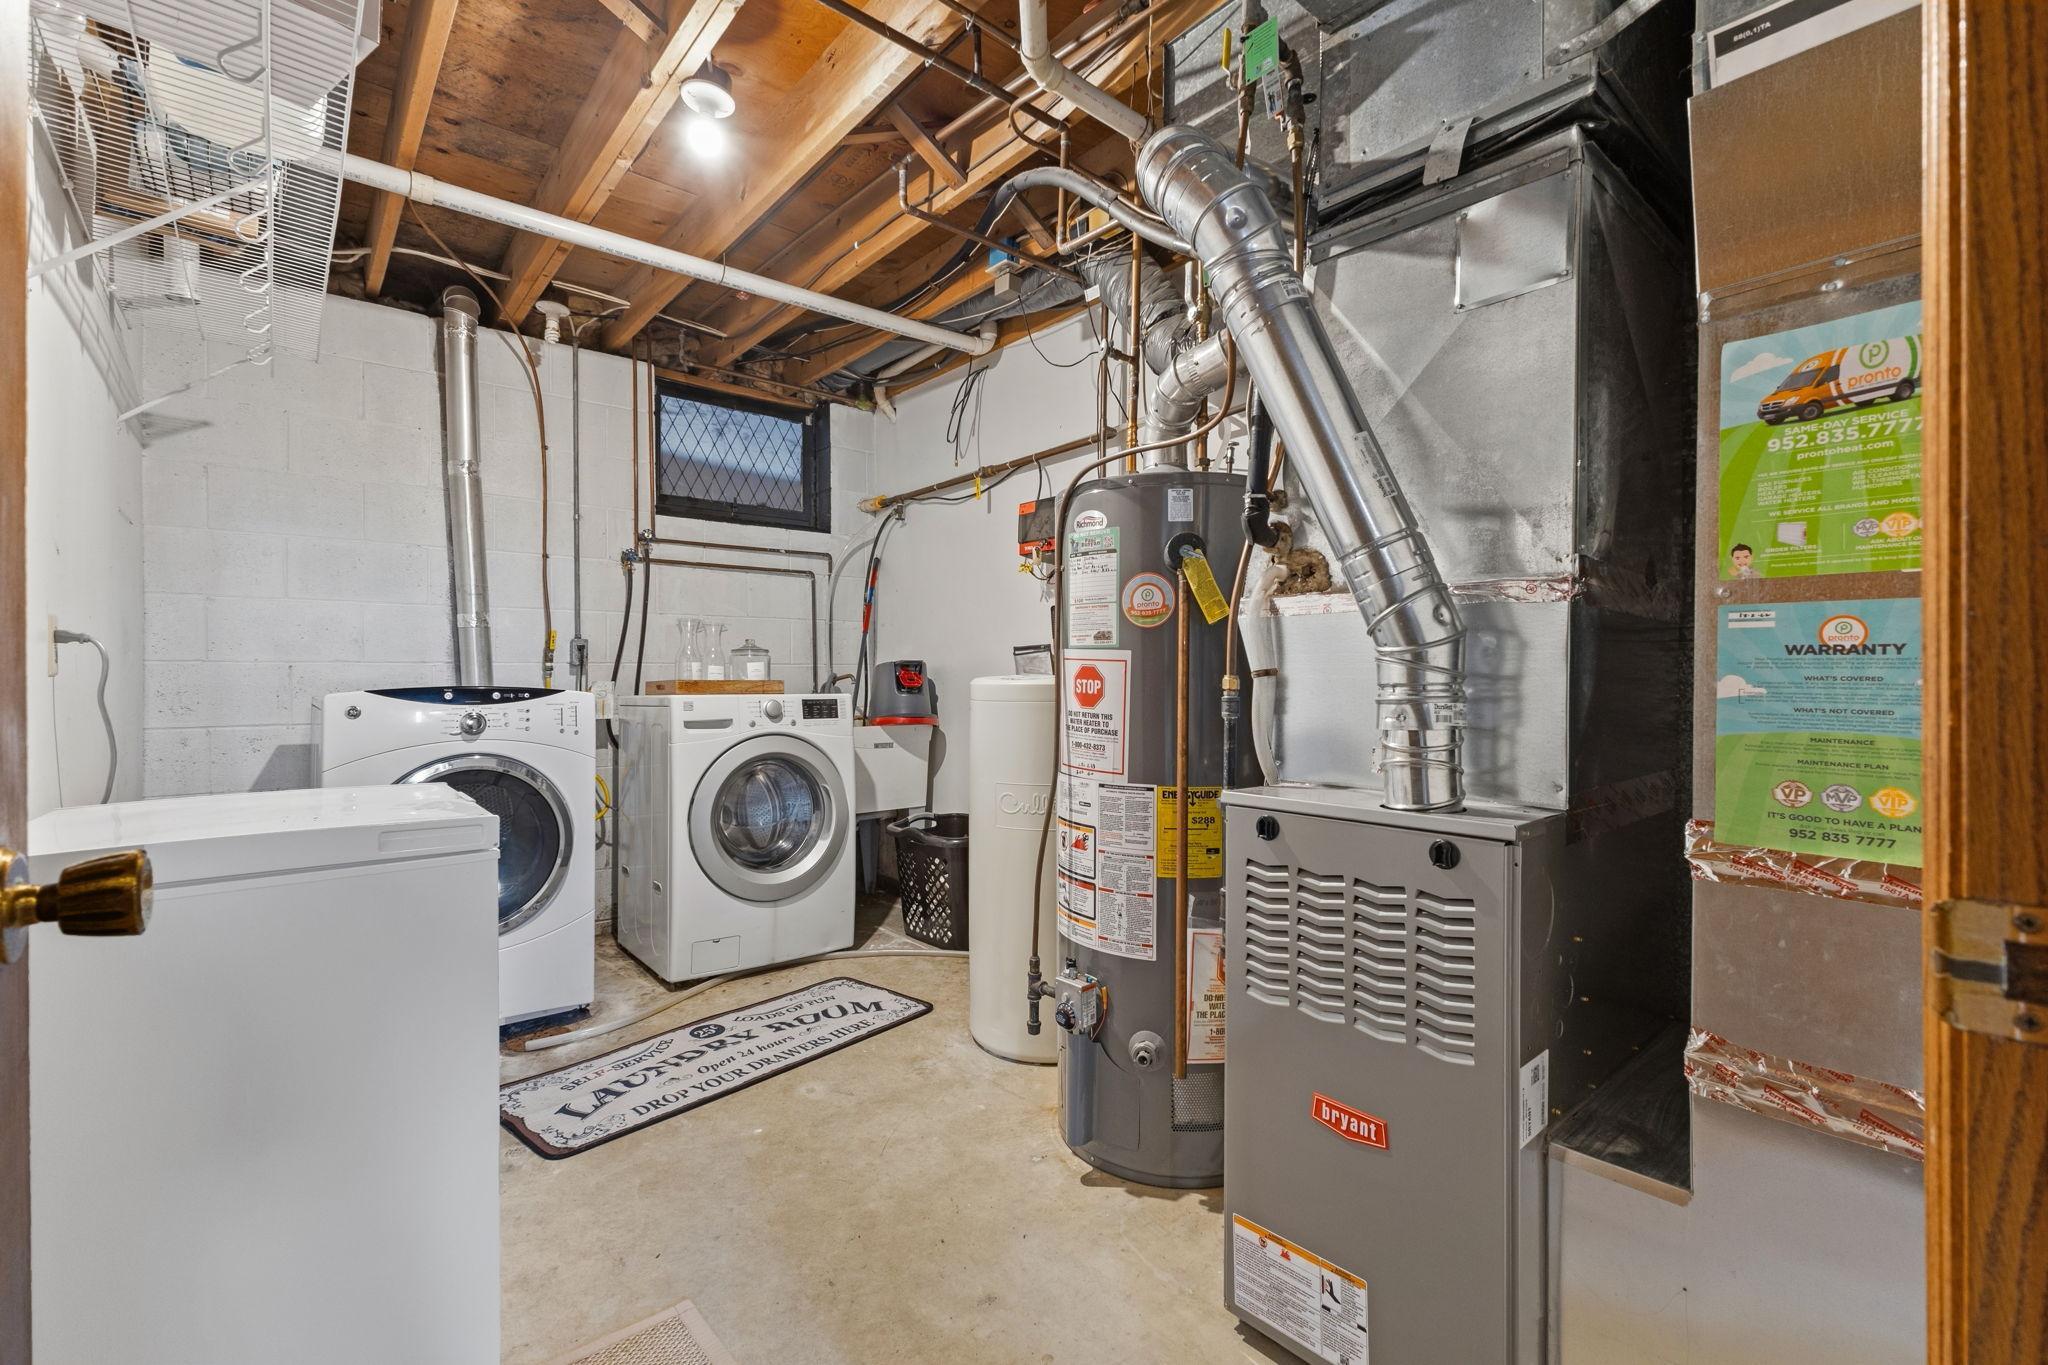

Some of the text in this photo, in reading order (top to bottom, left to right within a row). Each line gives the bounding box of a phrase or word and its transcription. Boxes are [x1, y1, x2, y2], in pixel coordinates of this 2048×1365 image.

[1847, 365, 1902, 388] pronto
[1784, 409, 1908, 436] SAME-DAY SERVICE
[1797, 440, 1894, 461] prontoheat.com
[1783, 507, 1815, 516] SERVICE
[1817, 505, 1832, 513] ALL
[1834, 502, 1868, 511] BRANDS
[1076, 516, 1104, 528] Richmond
[1855, 521, 1879, 533] MVP
[1136, 600, 1160, 609] pronto
[1828, 633, 1860, 642] pronto
[1785, 643, 1907, 656] WARRANTY
[1076, 679, 1102, 695] STOP
[1081, 711, 1099, 720] RETURN
[1083, 719, 1101, 728] HEATER
[1091, 727, 1119, 737] PURCHASE
[1810, 737, 1875, 746] MAINTENANCE
[1797, 759, 1861, 769] MAINTENANCE
[1780, 787, 1806, 799] VP
[1826, 792, 1857, 803] MVP
[1767, 811, 1786, 820] IT'S
[1788, 813, 1822, 823] GOOD
[1824, 816, 1840, 825] TO
[1843, 819, 1874, 829] HAVE
[1876, 822, 1887, 830] A
[1889, 823, 1922, 833] PLAN
[1789, 828, 1816, 840] 952
[1821, 831, 1850, 844] 835
[1855, 835, 1897, 849] 7777
[1204, 994, 1225, 1002] DO NO
[733, 995, 836, 1022] LOADS OF FUN
[554, 1000, 888, 1120] LAUNDRY ROOM
[697, 1034, 796, 1074] Open 24 hours
[560, 1038, 674, 1092] SELF-SERVICE
[630, 1019, 875, 1117] DROP YOUR DRAWERS HERE
[1321, 1102, 1377, 1141] bryant
